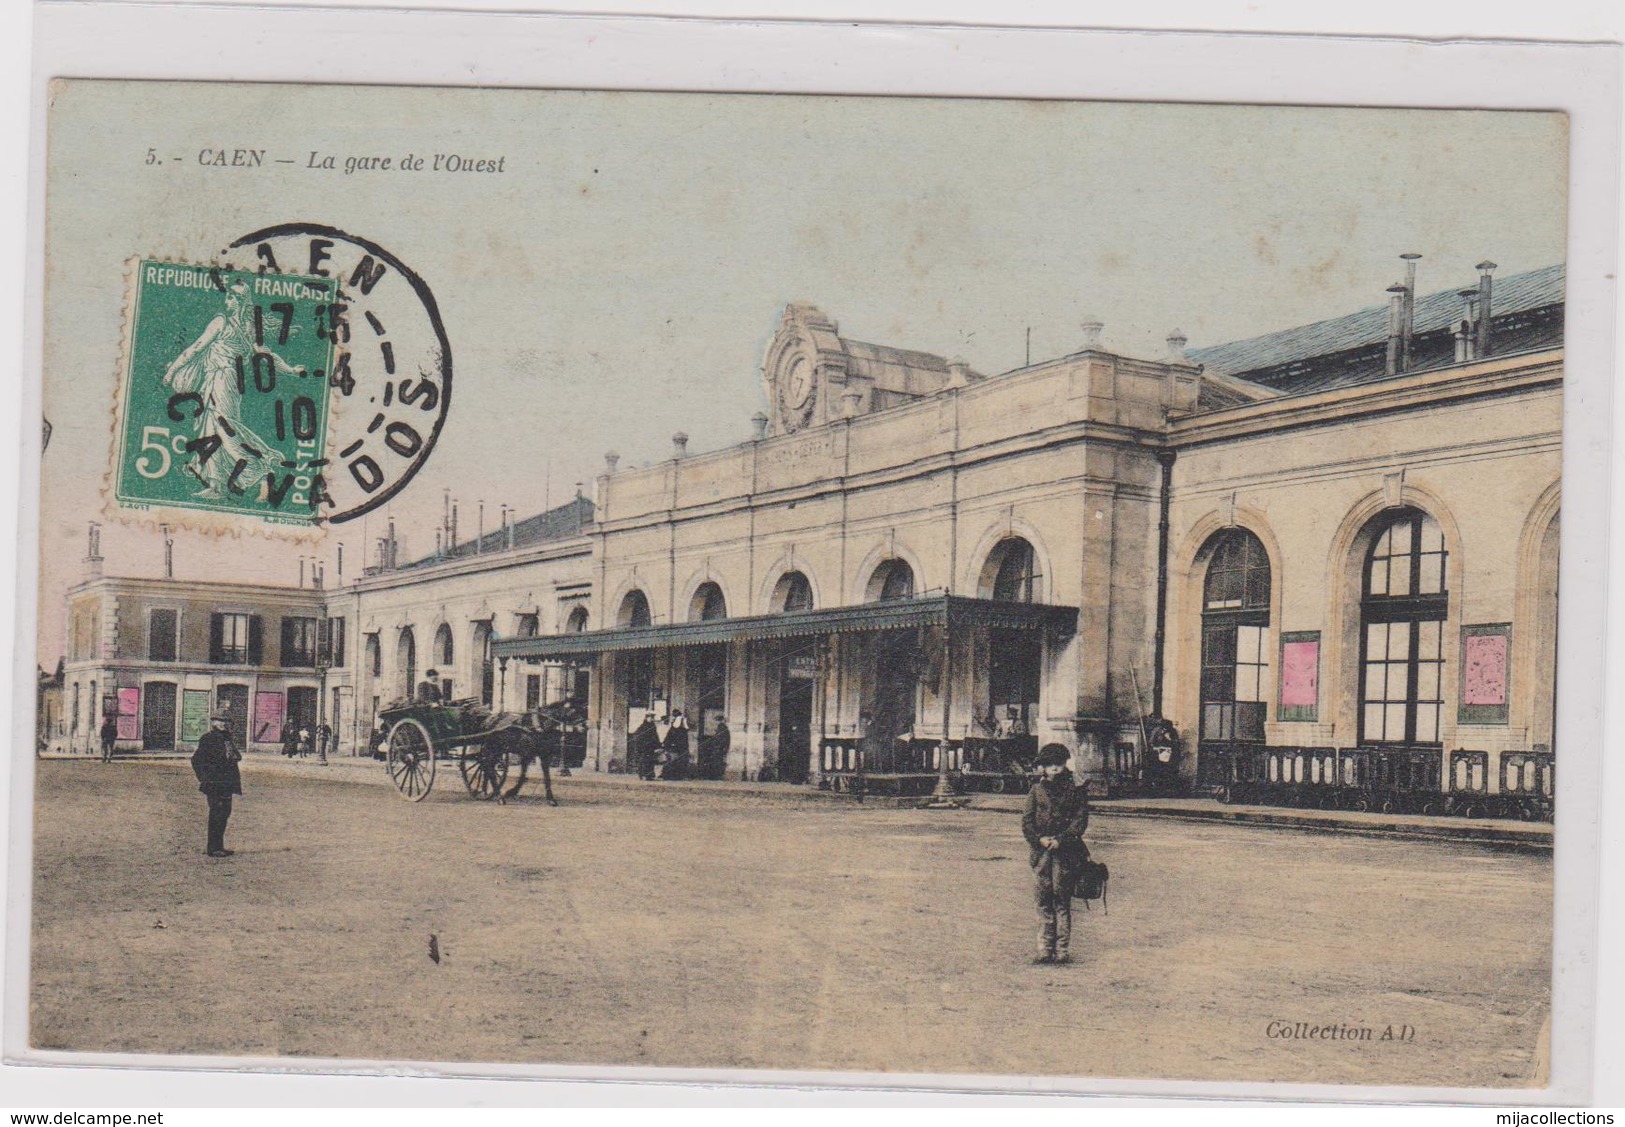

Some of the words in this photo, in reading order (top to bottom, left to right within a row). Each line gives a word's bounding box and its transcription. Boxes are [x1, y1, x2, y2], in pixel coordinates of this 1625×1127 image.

[145, 148, 163, 166] 5.
[198, 148, 266, 168] CAEN
[306, 151, 336, 170] La
[344, 155, 392, 176] gare
[400, 153, 425, 172] de
[433, 153, 506, 173] l'Ouest
[254, 303, 294, 347] 17
[235, 353, 276, 394] 10
[275, 396, 317, 441] 10
[166, 376, 440, 512] CALVADOS
[291, 427, 316, 505] POSTE
[1266, 1021, 1373, 1041] Collection
